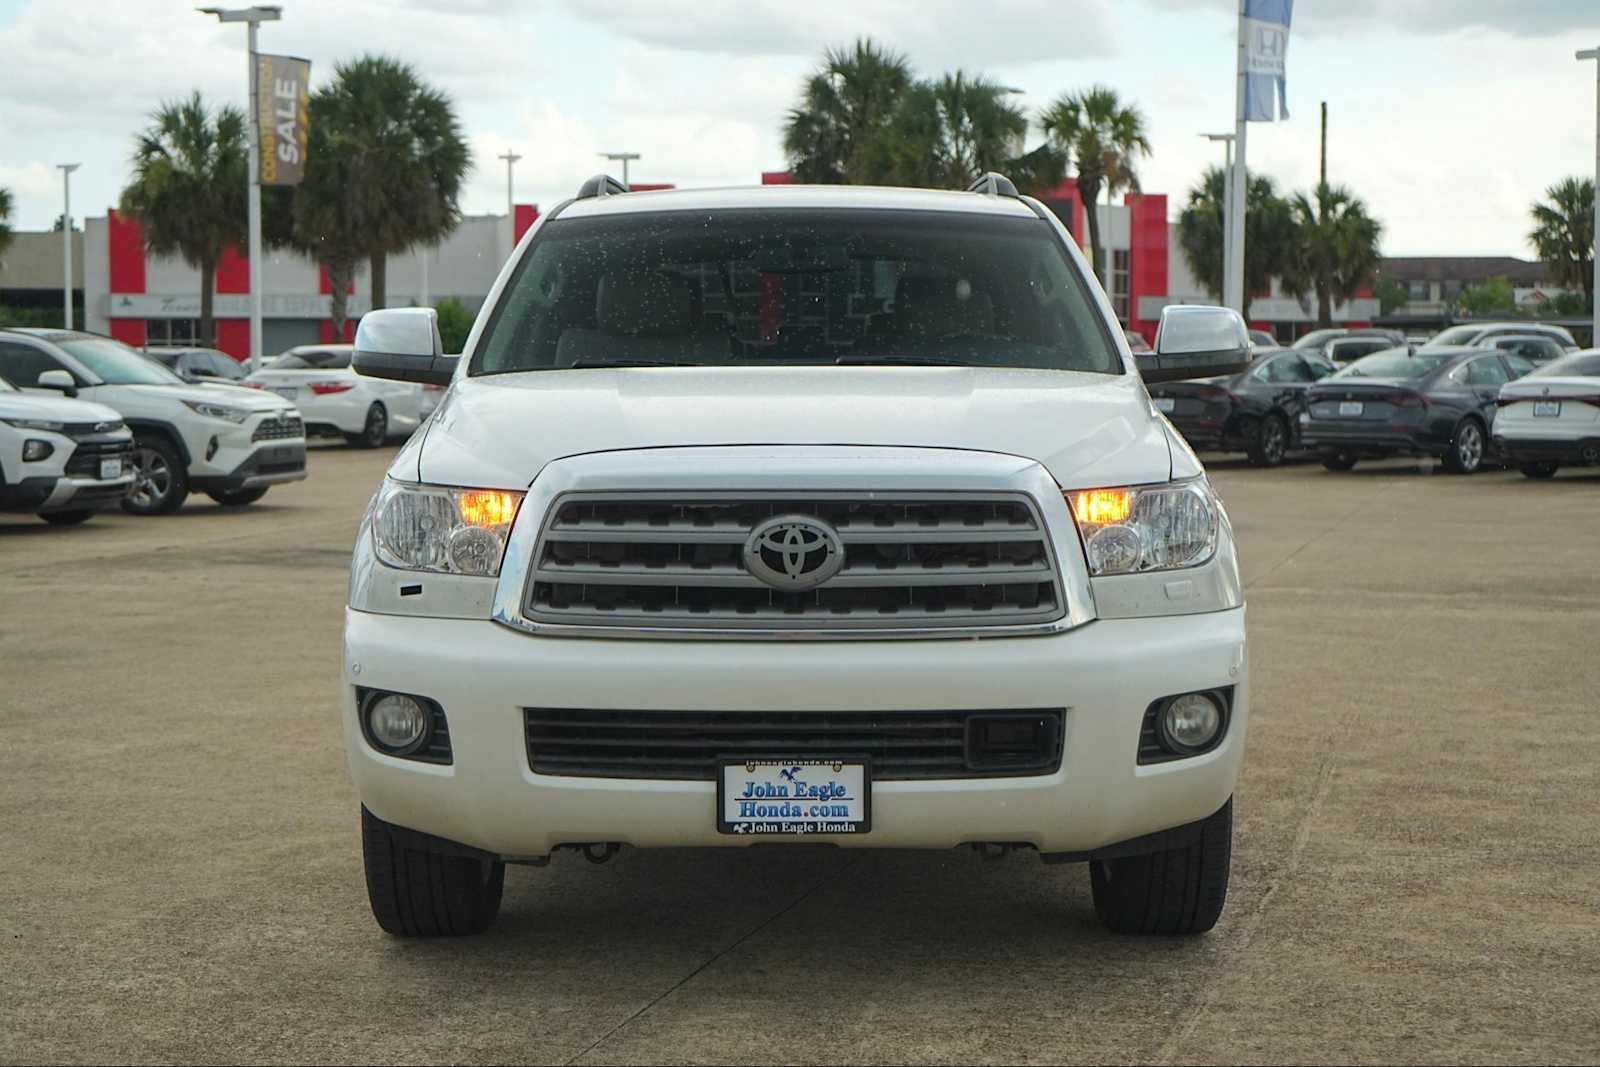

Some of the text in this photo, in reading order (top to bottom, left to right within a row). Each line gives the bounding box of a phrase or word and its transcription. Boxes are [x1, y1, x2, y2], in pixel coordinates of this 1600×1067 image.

[275, 78, 299, 165] SALE
[742, 781, 846, 801] John Eagle
[739, 802, 849, 818] Honda.com
[749, 822, 856, 835] John Eagle Honda
